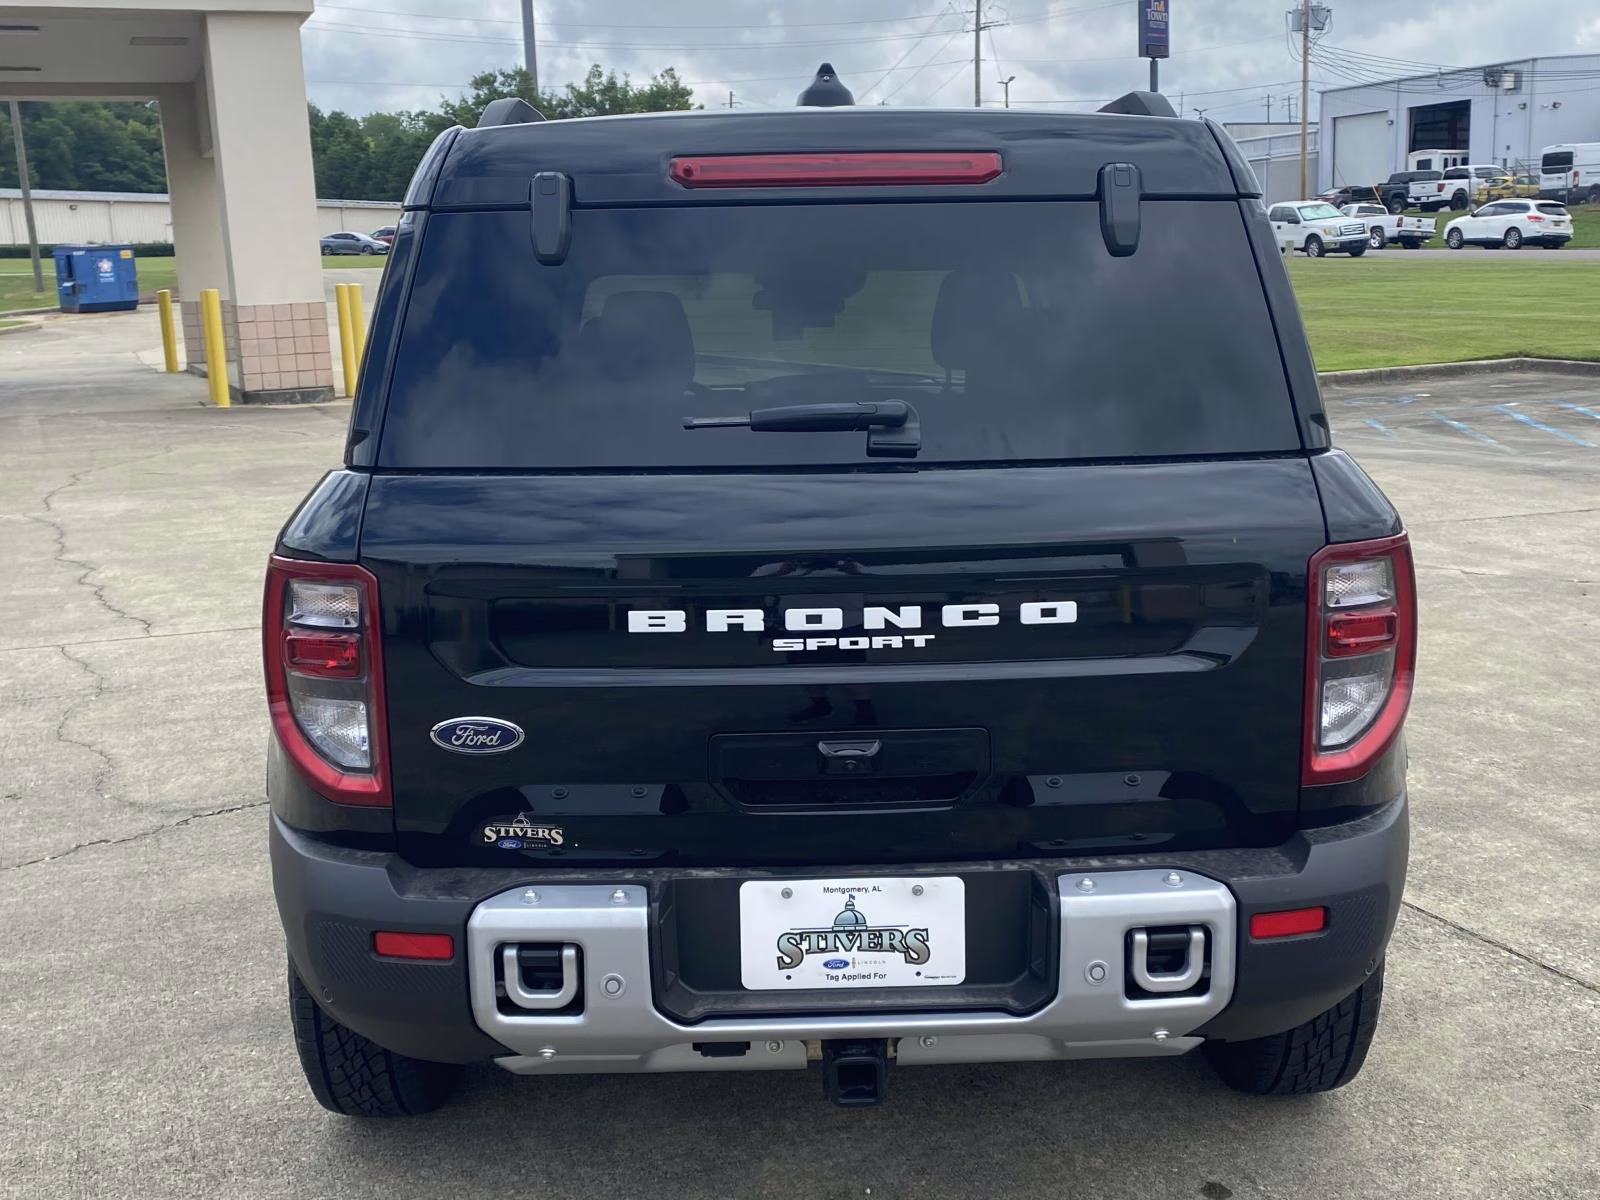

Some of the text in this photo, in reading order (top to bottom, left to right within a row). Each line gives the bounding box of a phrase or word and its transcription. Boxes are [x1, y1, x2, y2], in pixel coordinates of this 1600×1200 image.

[1145, 8, 1168, 21] Town
[627, 600, 1078, 633] BRONCO
[772, 634, 935, 651] SPORT
[451, 724, 502, 746] Ford
[484, 826, 564, 846] STIVERS
[823, 886, 869, 894] Montgomery,
[777, 928, 931, 970] STIVERS
[841, 973, 871, 981] Applied
[873, 972, 887, 980] For
